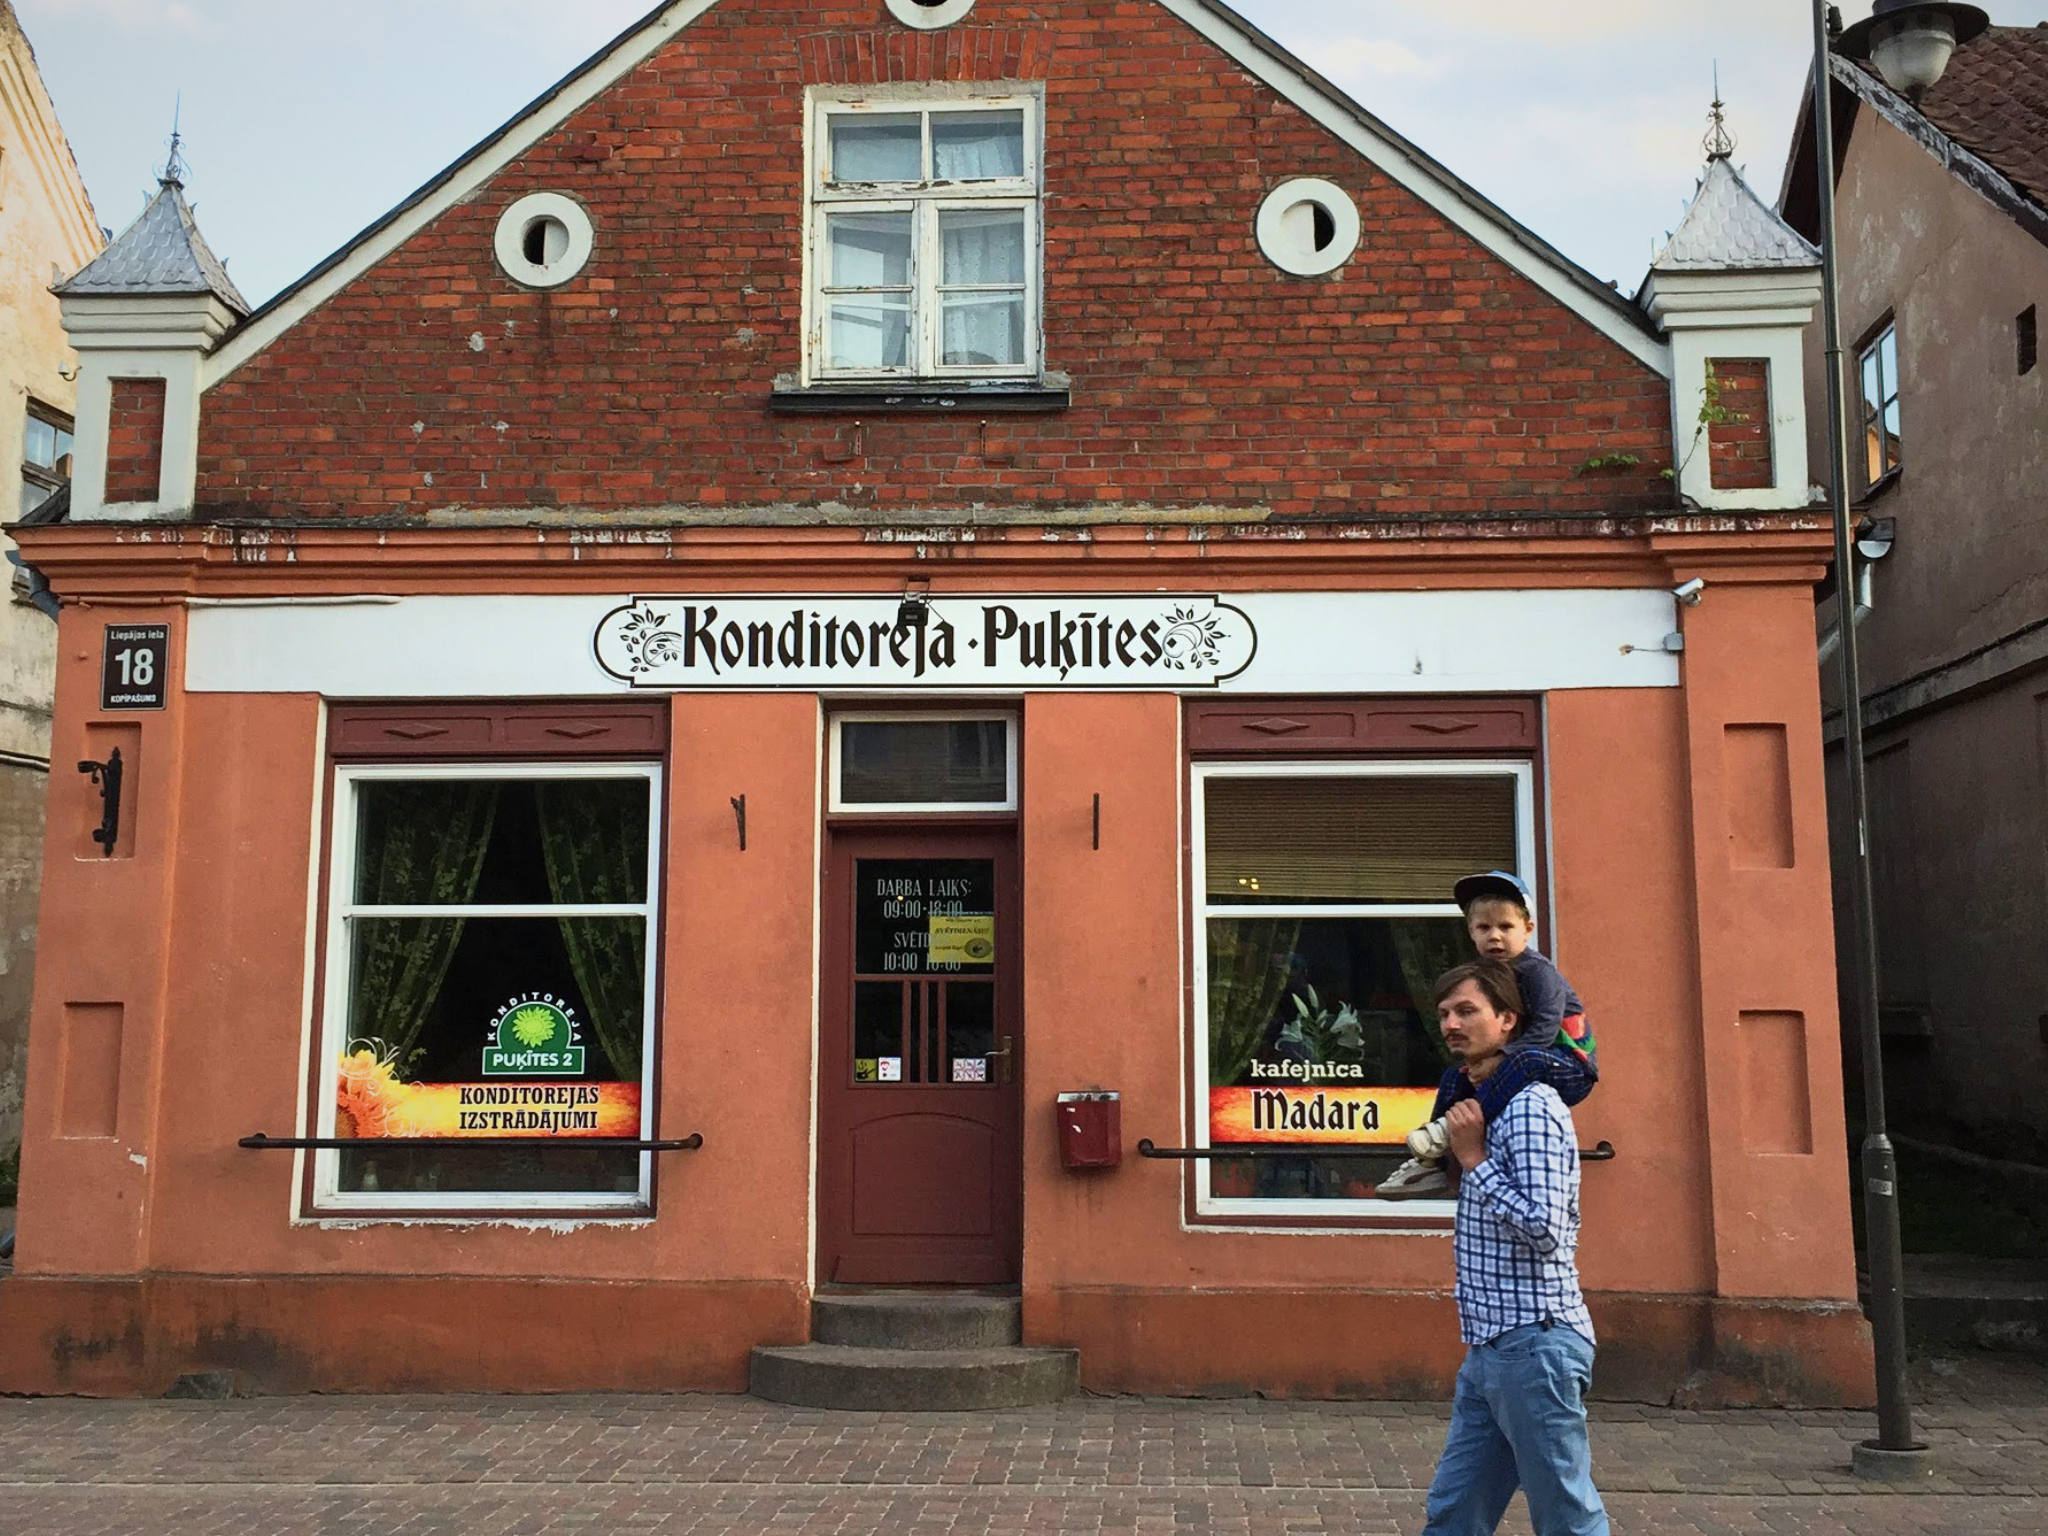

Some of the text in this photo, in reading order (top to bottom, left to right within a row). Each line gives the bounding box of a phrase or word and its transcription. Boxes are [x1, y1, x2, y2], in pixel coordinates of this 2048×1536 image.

[110, 630, 164, 641] Liepājas iela
[683, 604, 1163, 681] Konditoreja Puķītes
[115, 648, 153, 685] 18
[877, 878, 922, 896] DARBA
[883, 951, 918, 971] 10:00
[487, 991, 582, 1041] KONDITOREJA
[493, 1050, 573, 1070] PUĶĪTES 2
[1250, 1058, 1364, 1081] kafejnīca
[459, 1087, 599, 1109] KONDITOREJAS
[1251, 1088, 1380, 1131] Madara
[458, 1109, 598, 1134] IZSTRĀDĀJUMI
